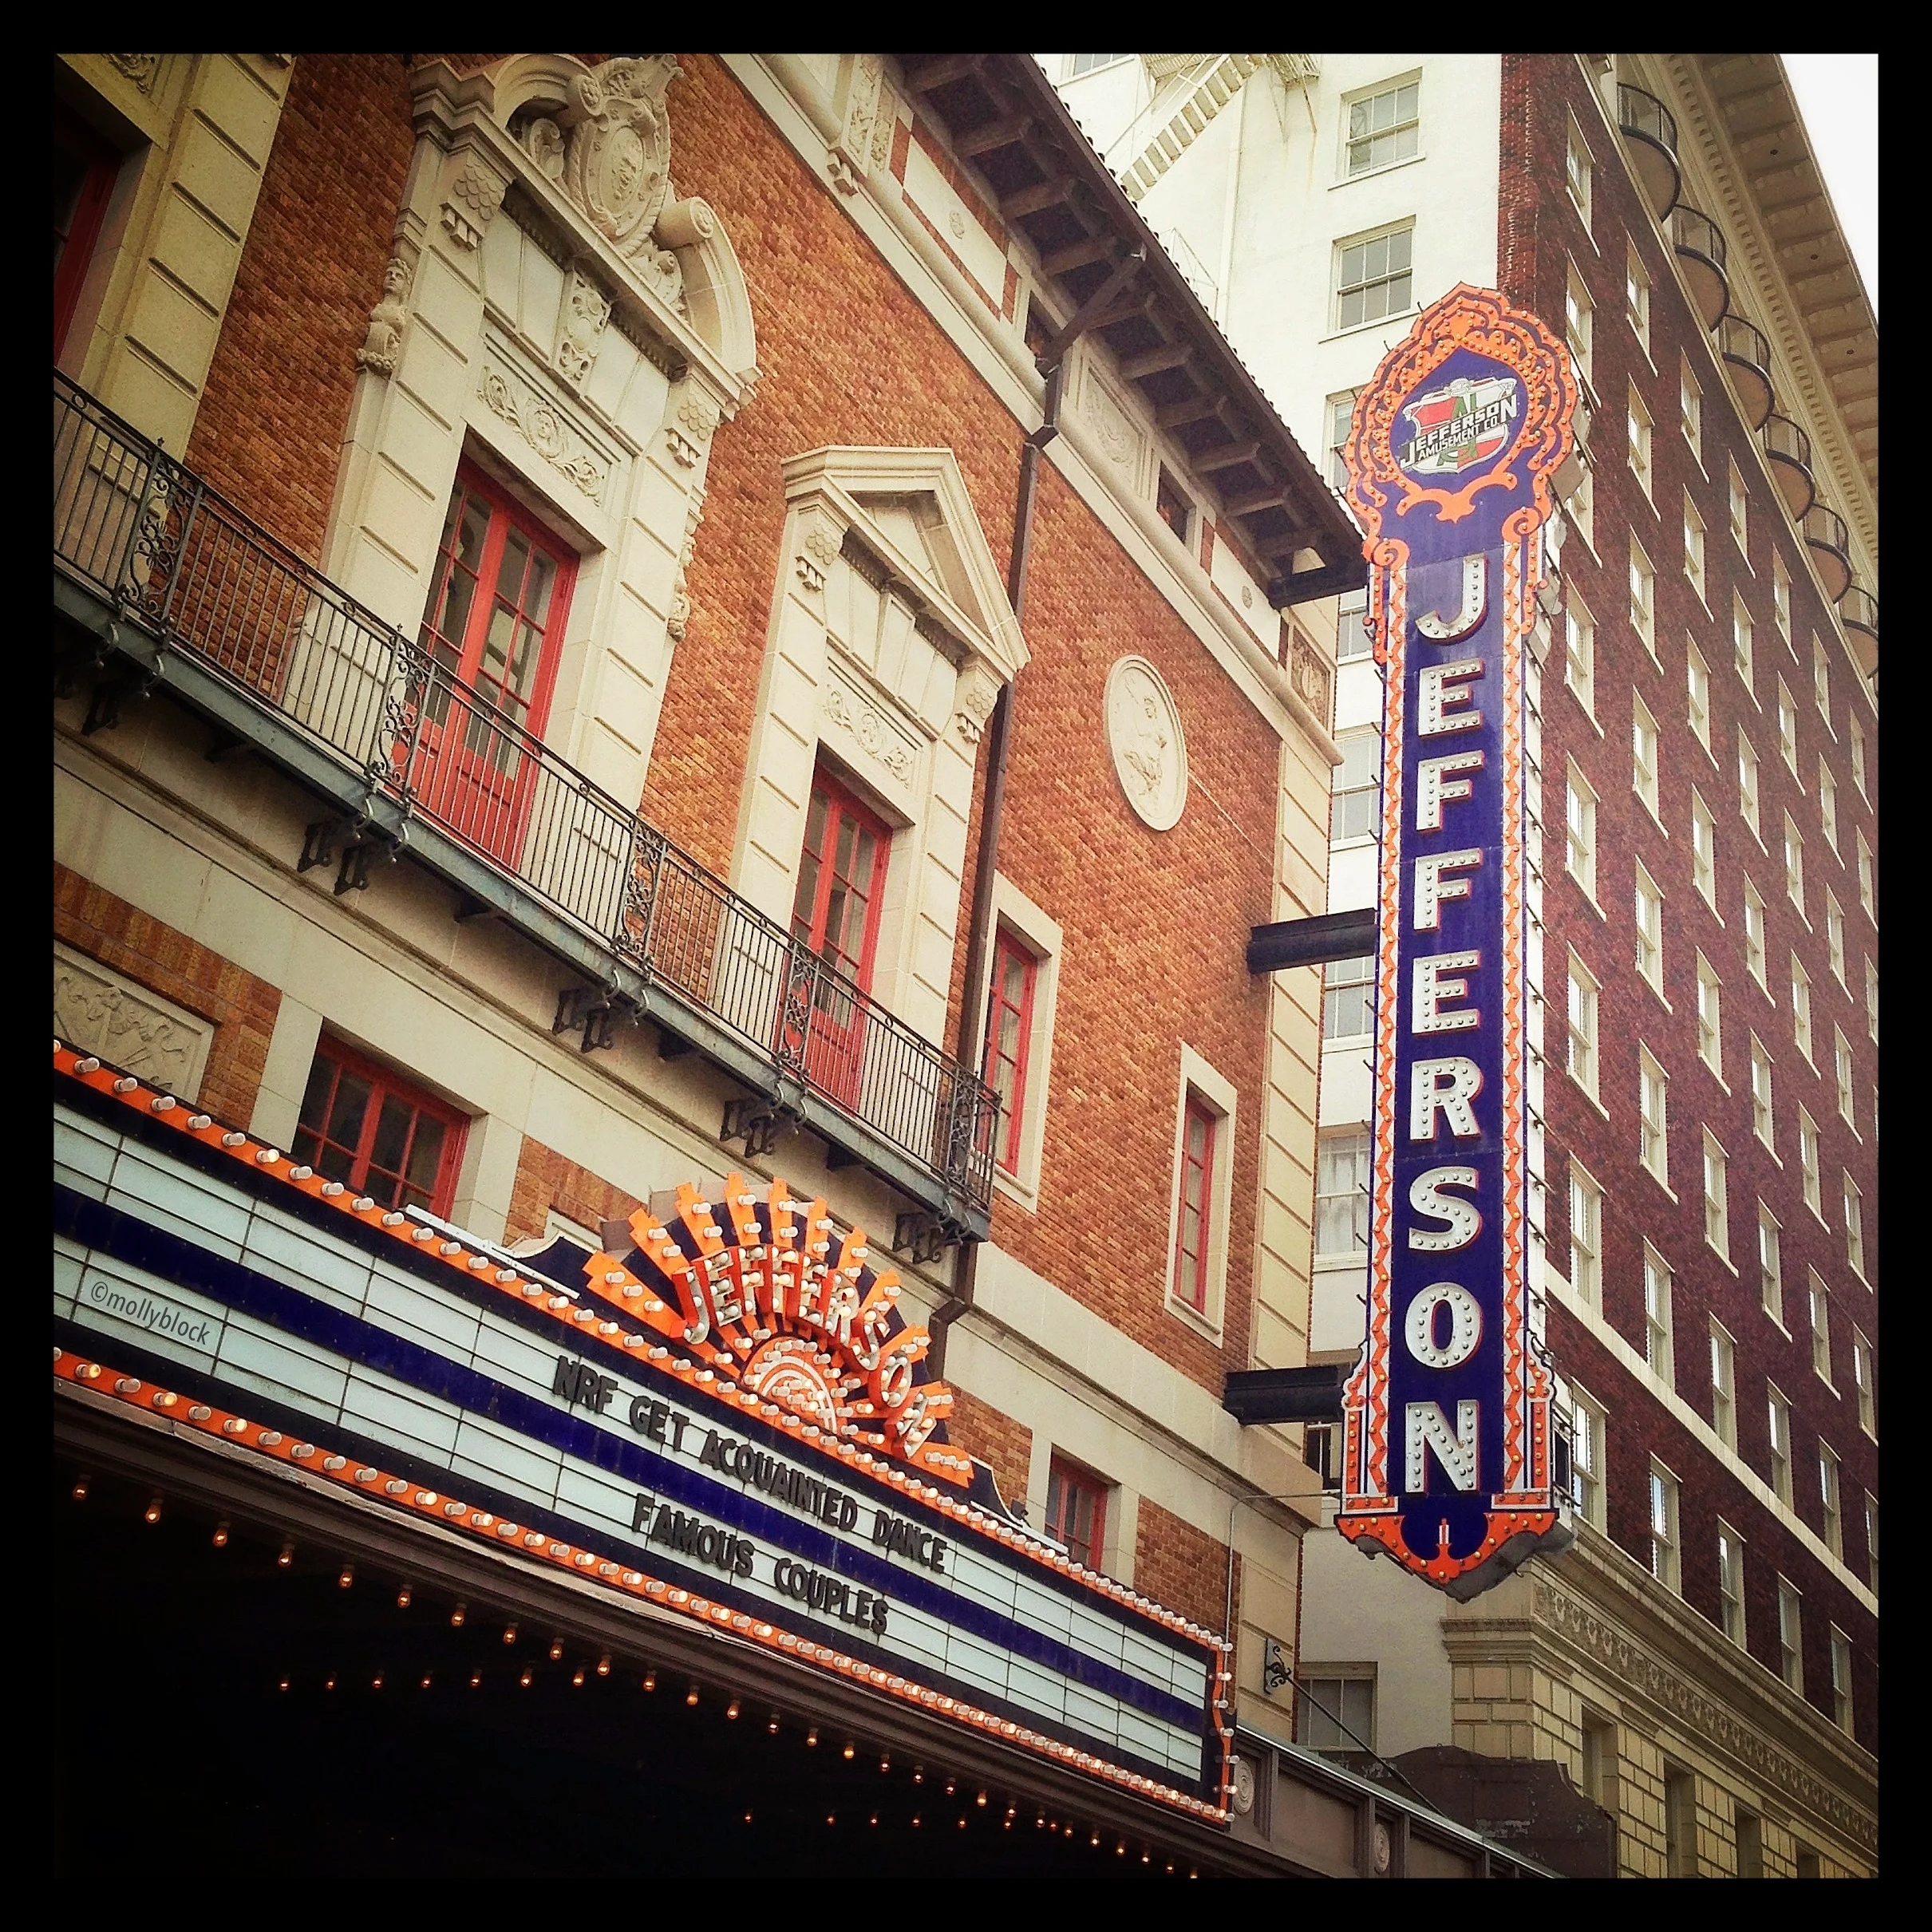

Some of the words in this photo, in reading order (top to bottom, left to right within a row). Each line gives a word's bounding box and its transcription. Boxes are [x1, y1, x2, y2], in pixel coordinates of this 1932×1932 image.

[1401, 394, 1517, 468] JEFFERSON
[1418, 422, 1480, 461] AMUSEMENT
[1484, 415, 1500, 429] CO.
[1405, 553, 1490, 1495] JEFFERSON
[670, 1243, 937, 1458] JEFFERSON
[552, 1355, 618, 1414] NRF
[629, 1395, 689, 1452] GET
[699, 1428, 858, 1532] ACQUAINTED
[872, 1510, 947, 1574] DANCE
[632, 1492, 755, 1578] FAMOUS
[774, 1558, 889, 1636] COUPLES
